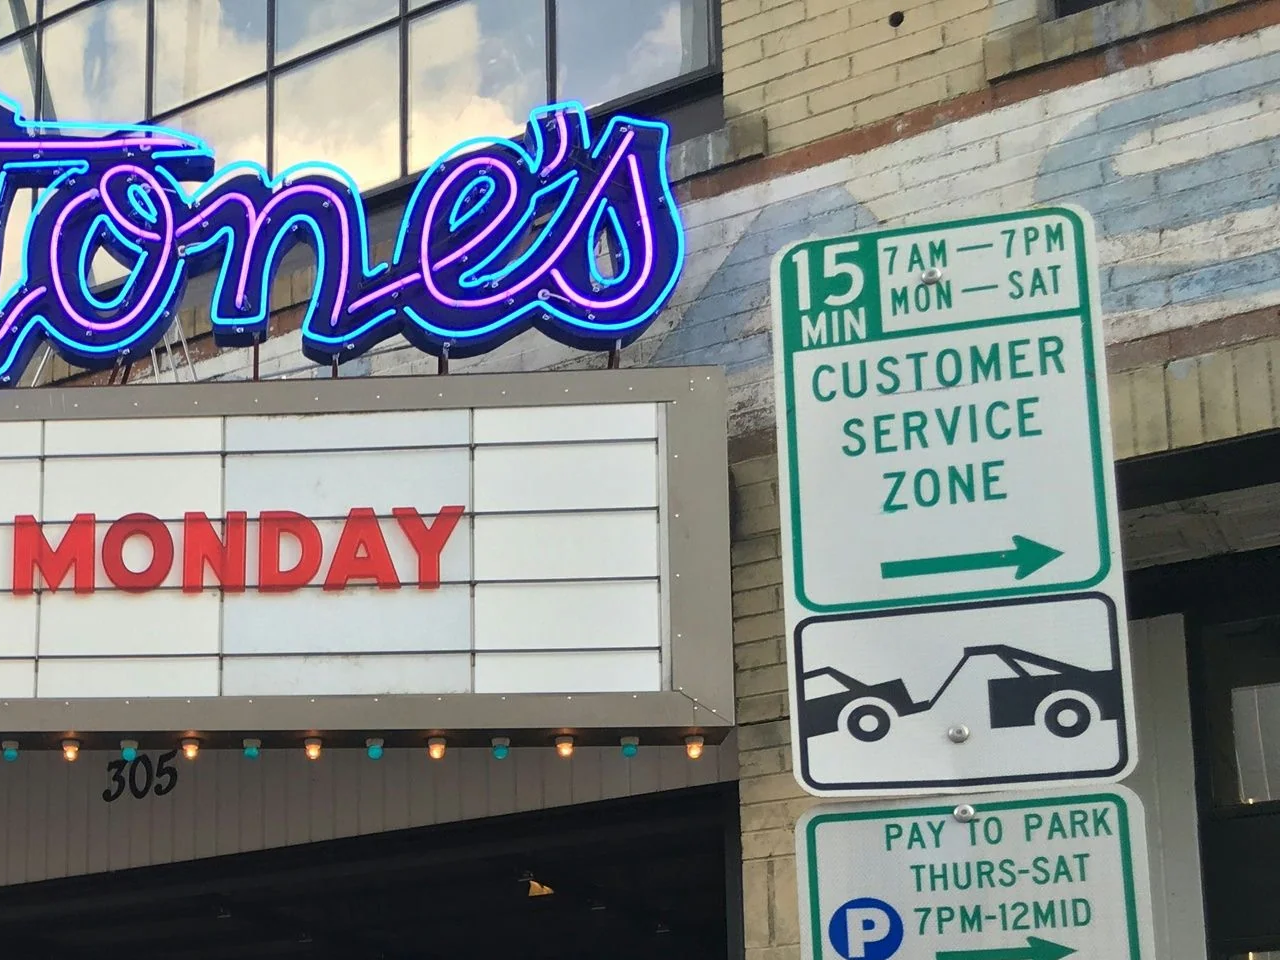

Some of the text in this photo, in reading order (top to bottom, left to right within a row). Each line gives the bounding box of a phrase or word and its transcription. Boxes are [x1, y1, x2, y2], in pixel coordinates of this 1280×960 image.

[883, 239, 948, 275] 7AM
[1000, 222, 1065, 258] 7PM
[791, 241, 865, 311] 15
[891, 281, 952, 316] MON
[1008, 265, 1061, 300] SAT
[800, 307, 867, 348] MIN
[812, 335, 1065, 402] CUSTOMER
[841, 397, 1042, 457] SERVICE
[882, 460, 1007, 513] ZONE
[11, 505, 466, 594] MONDAY
[102, 748, 178, 802] 305
[884, 807, 1112, 851] PAY TO PARK
[910, 853, 1090, 892] THURS-SAT
[845, 898, 1092, 958] P 7PM-12MID
